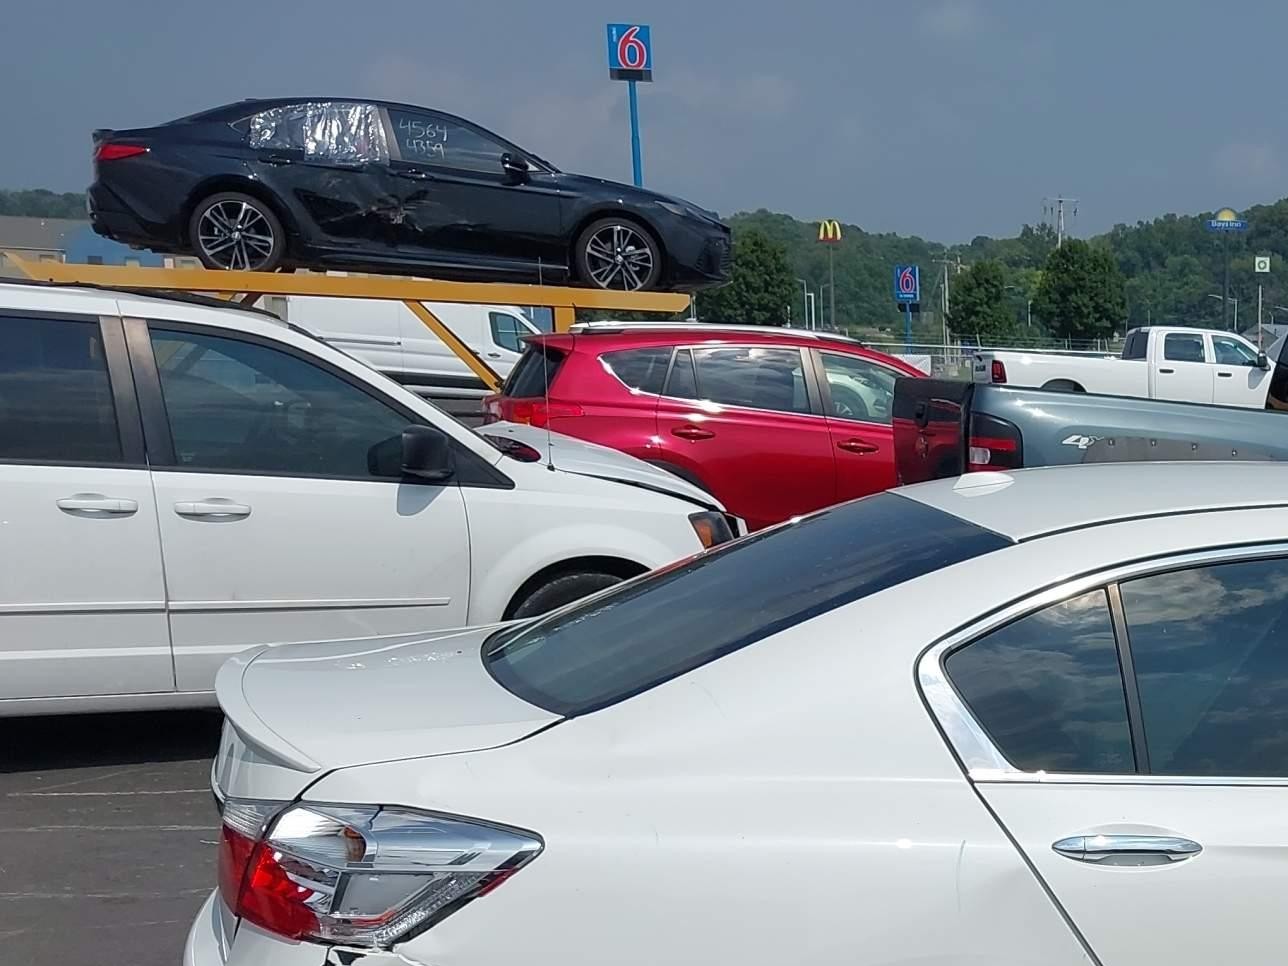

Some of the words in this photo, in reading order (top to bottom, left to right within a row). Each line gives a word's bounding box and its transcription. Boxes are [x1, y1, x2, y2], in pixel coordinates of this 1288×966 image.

[617, 26, 647, 69] 6
[400, 119, 447, 141] 4564
[899, 267, 915, 293] 6
